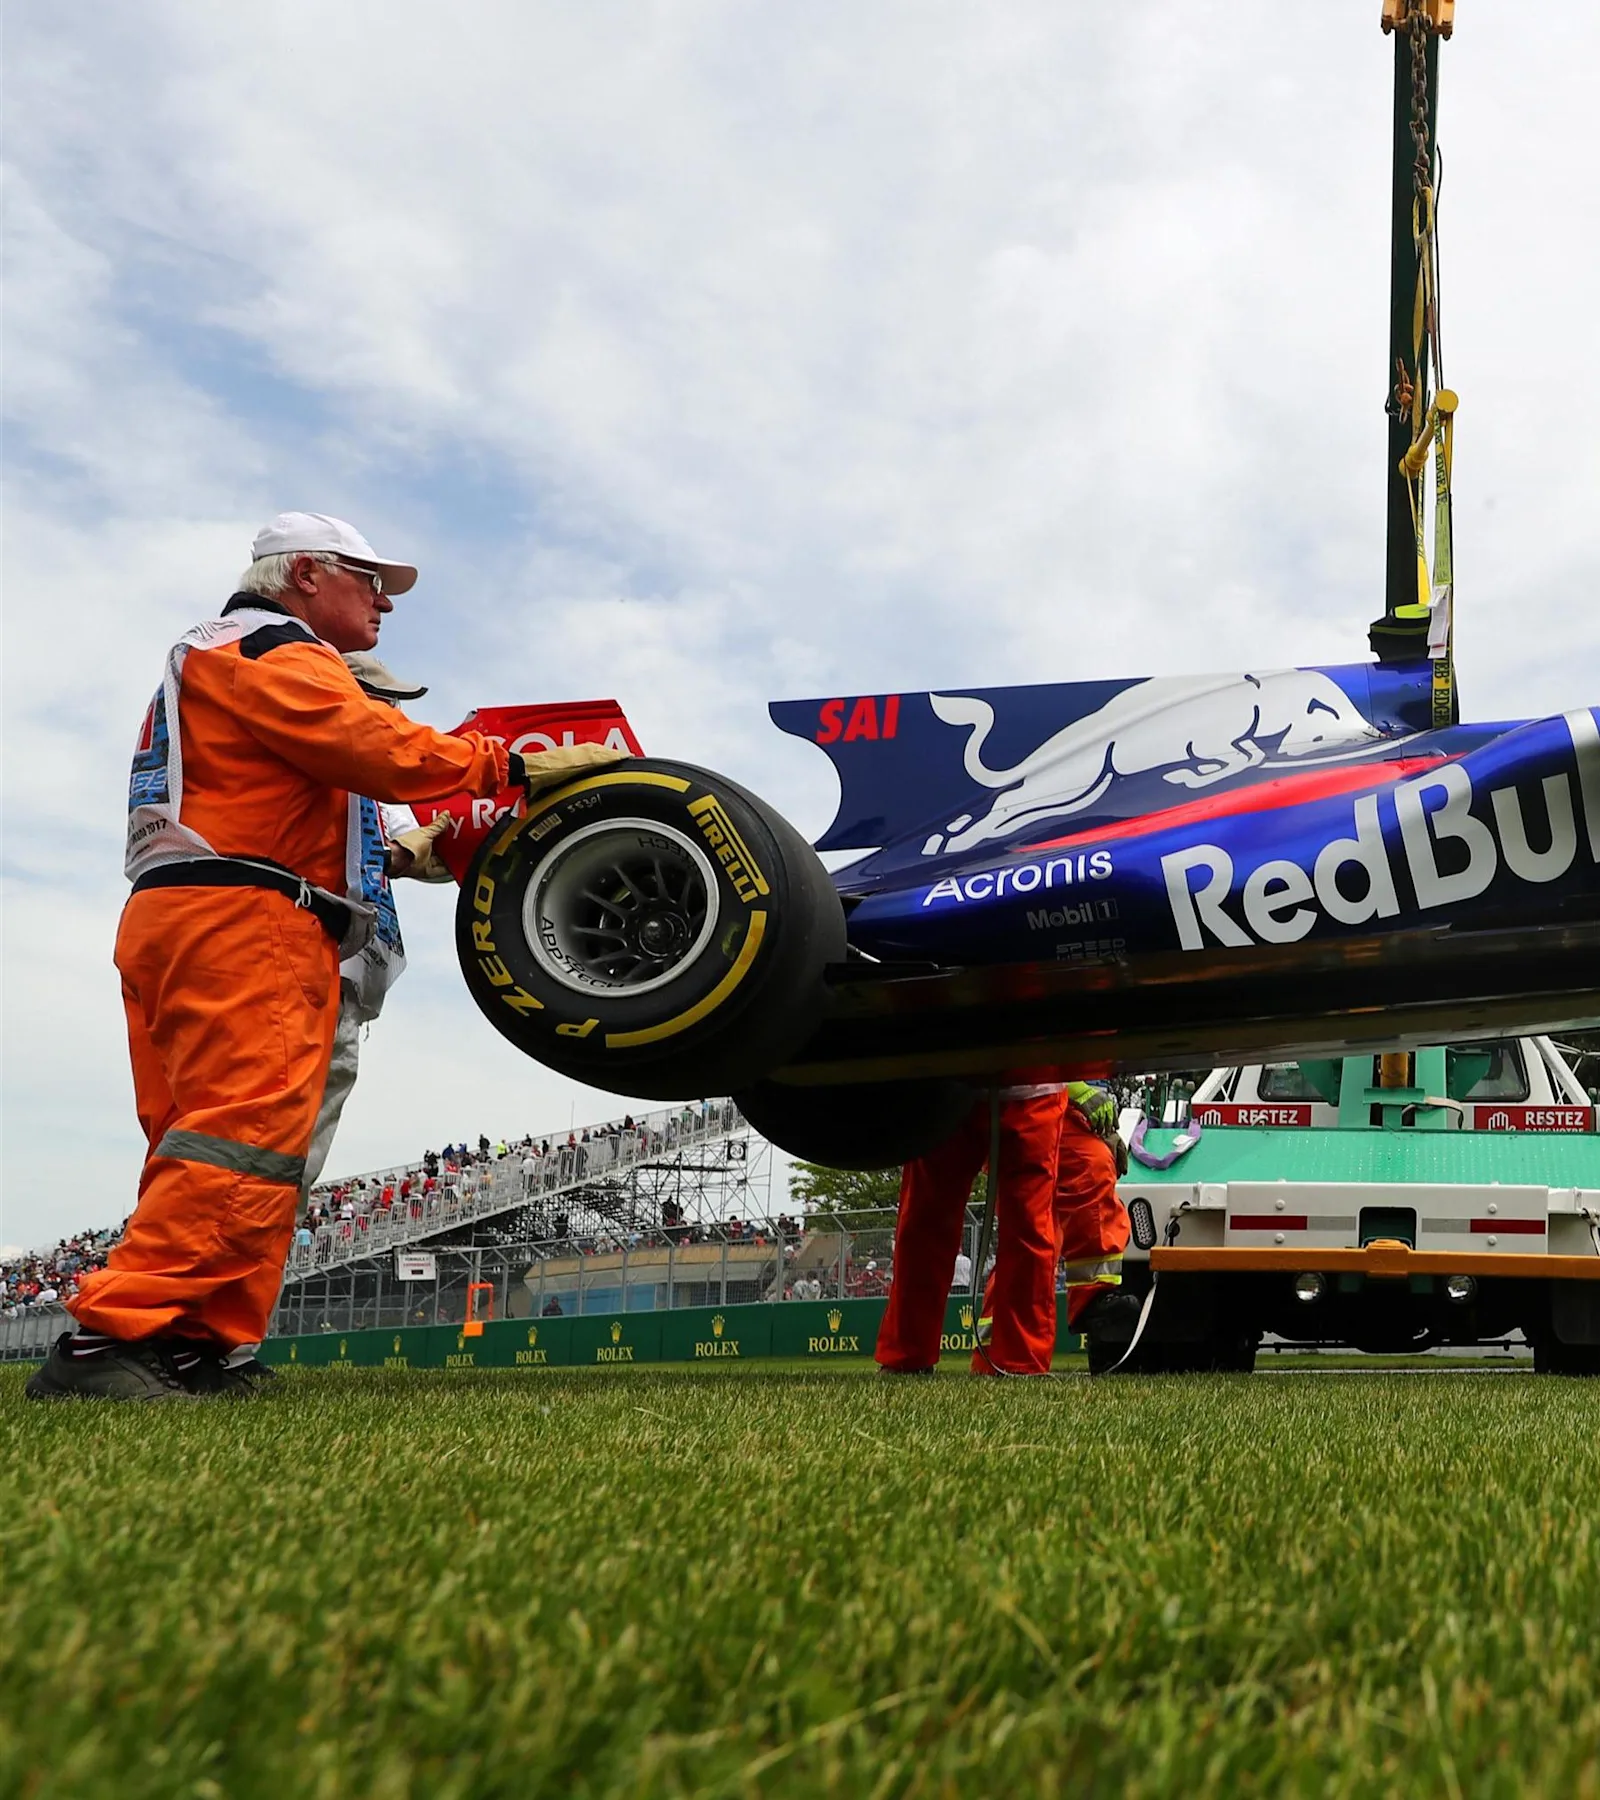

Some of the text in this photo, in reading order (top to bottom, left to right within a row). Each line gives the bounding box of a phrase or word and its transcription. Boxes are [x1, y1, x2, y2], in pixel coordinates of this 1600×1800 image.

[815, 693, 902, 744] SAI
[686, 794, 770, 904] PIRELLI
[922, 849, 1113, 907] Acronis
[1026, 902, 1094, 931] Mobil
[472, 872, 545, 1017] ZERO
[1238, 1108, 1298, 1125] RESTEZ
[1525, 1110, 1584, 1126] RESTEZ
[695, 1340, 740, 1357] ROLEX
[809, 1336, 859, 1352] ROLEX
[446, 1353, 475, 1367] ROLEX
[516, 1350, 547, 1364] ROLEX
[596, 1346, 634, 1362] ROLEX
